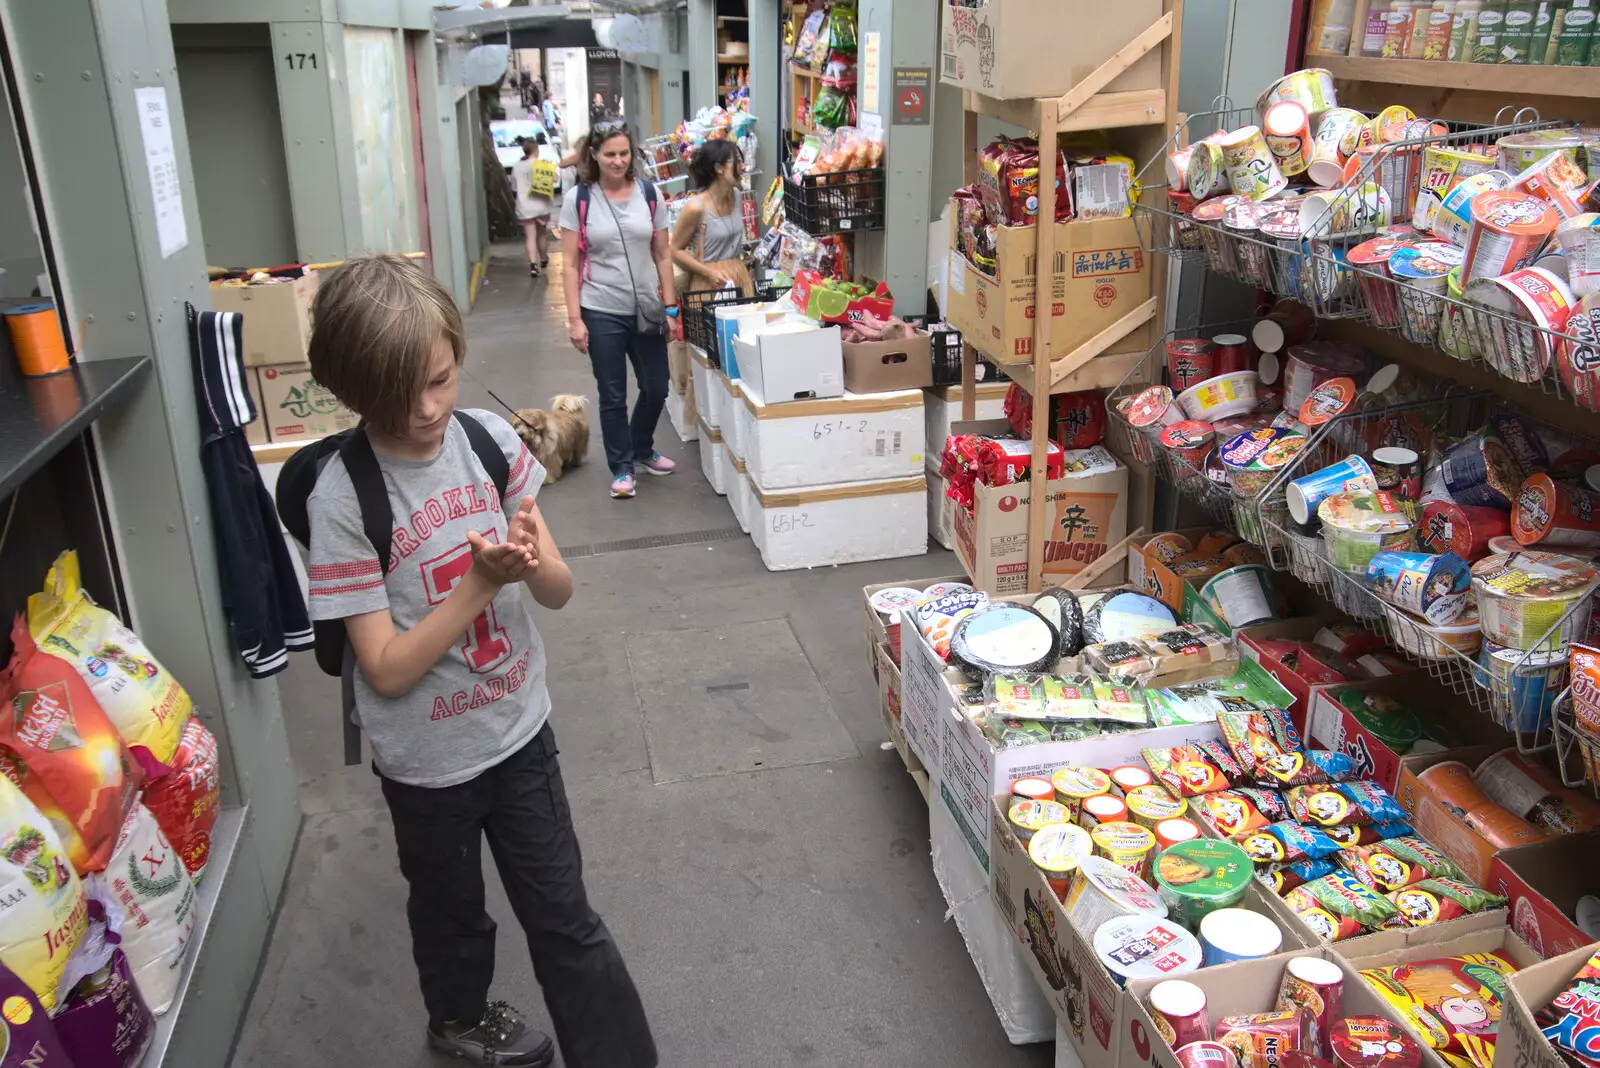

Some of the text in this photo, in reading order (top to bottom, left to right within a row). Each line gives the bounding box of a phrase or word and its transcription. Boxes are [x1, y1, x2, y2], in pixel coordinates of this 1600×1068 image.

[284, 53, 318, 70] 171
[1052, 304, 1065, 315] MUL
[1176, 358, 1199, 390] 辛
[1224, 437, 1253, 461] Bowl
[1232, 437, 1271, 464] Noodle
[1019, 493, 1067, 506] NOSHIM
[772, 513, 815, 532] 651-2
[1061, 504, 1090, 543] 辛
[997, 565, 1012, 574] MULTI
[921, 591, 989, 621] CLOVER
[940, 601, 976, 615] CHIPS
[111, 677, 127, 695] AAA
[430, 651, 531, 721] ACADEM
[151, 681, 181, 727] Jasmin
[17, 694, 60, 748] AKASH
[37, 708, 68, 750] BASMATI
[1405, 838, 1442, 868] AWANG
[1214, 880, 1234, 889] 120g
[42, 892, 88, 960] Jasmi
[1350, 1024, 1386, 1033] NEOGURI
